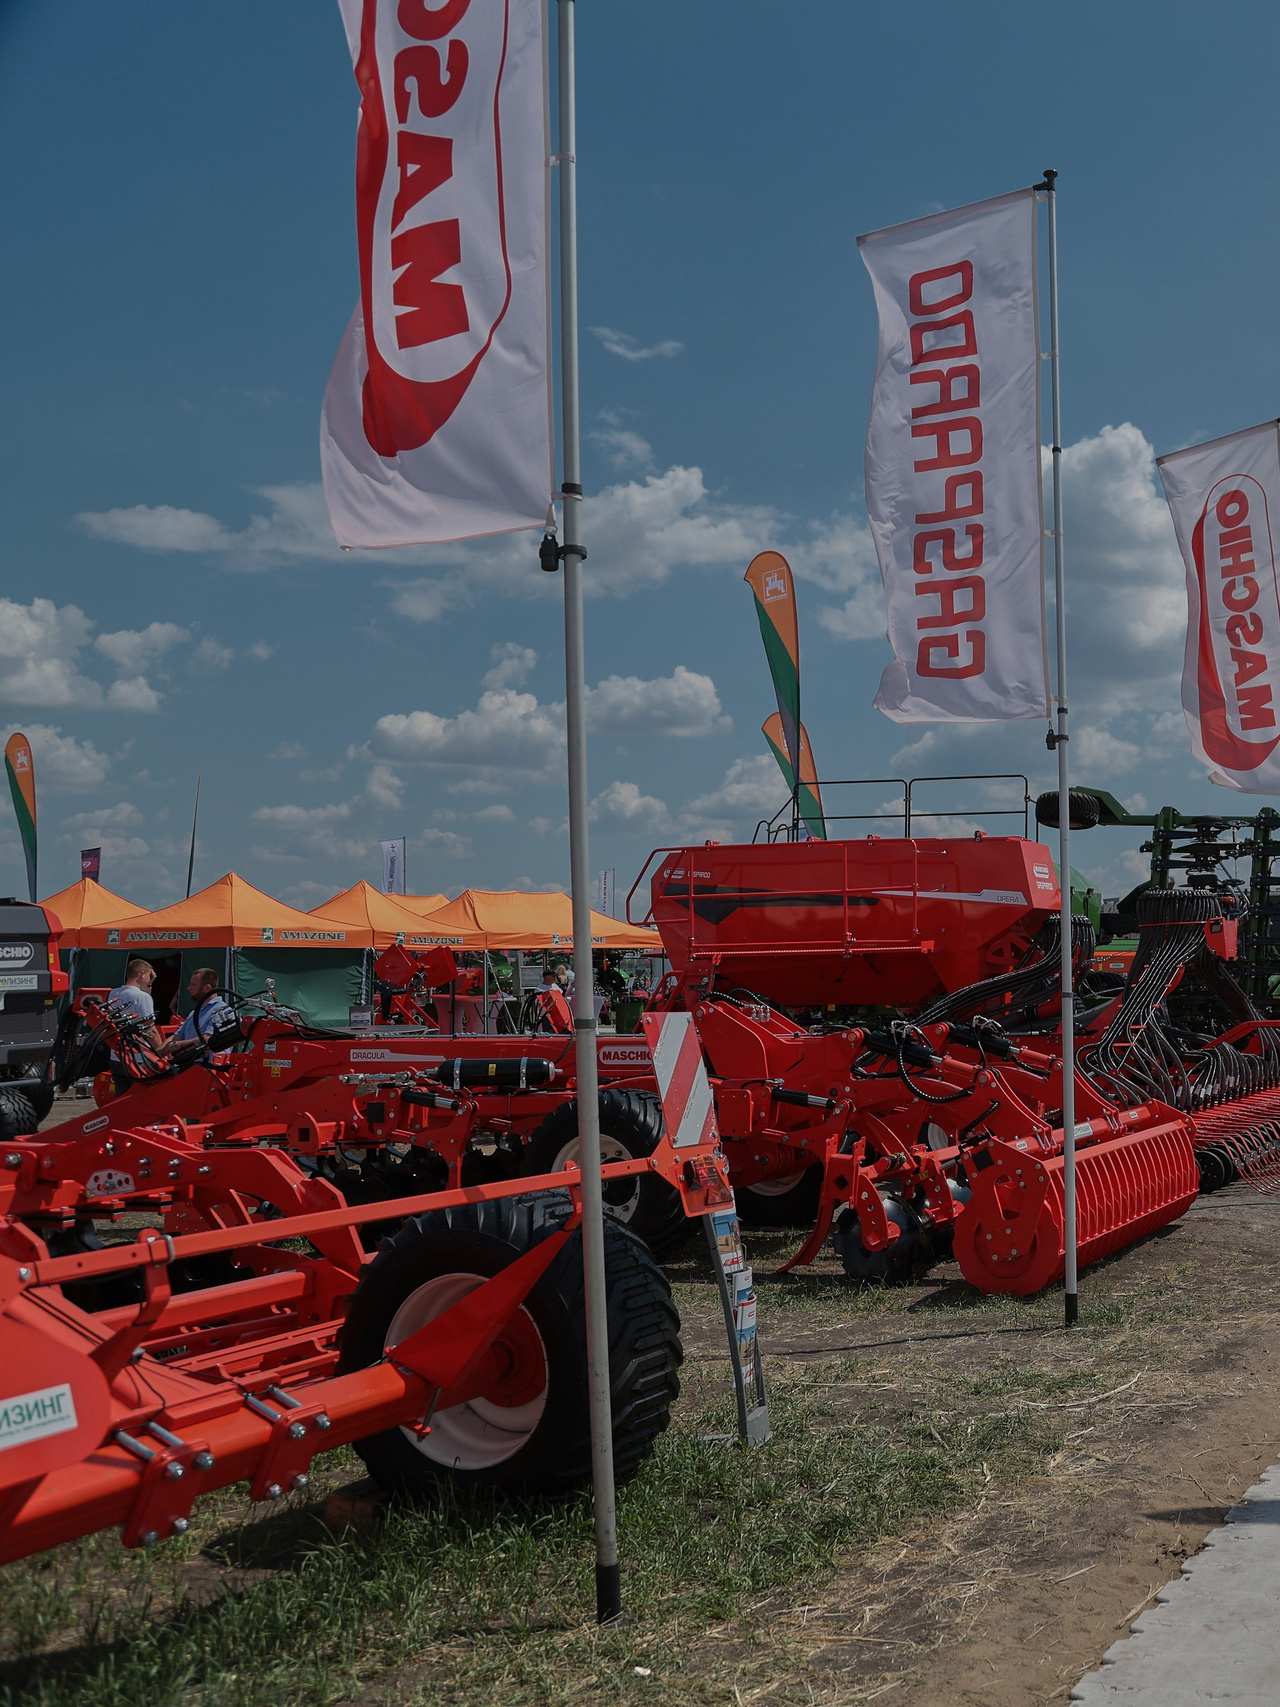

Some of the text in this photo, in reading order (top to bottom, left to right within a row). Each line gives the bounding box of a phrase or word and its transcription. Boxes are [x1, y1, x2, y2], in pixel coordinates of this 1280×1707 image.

[996, 895, 1020, 903] OPERA
[126, 931, 199, 941] AMAZONE
[279, 931, 346, 941] AMAZONE
[410, 935, 463, 945] AMAZONE
[352, 1052, 385, 1060] DRACULA
